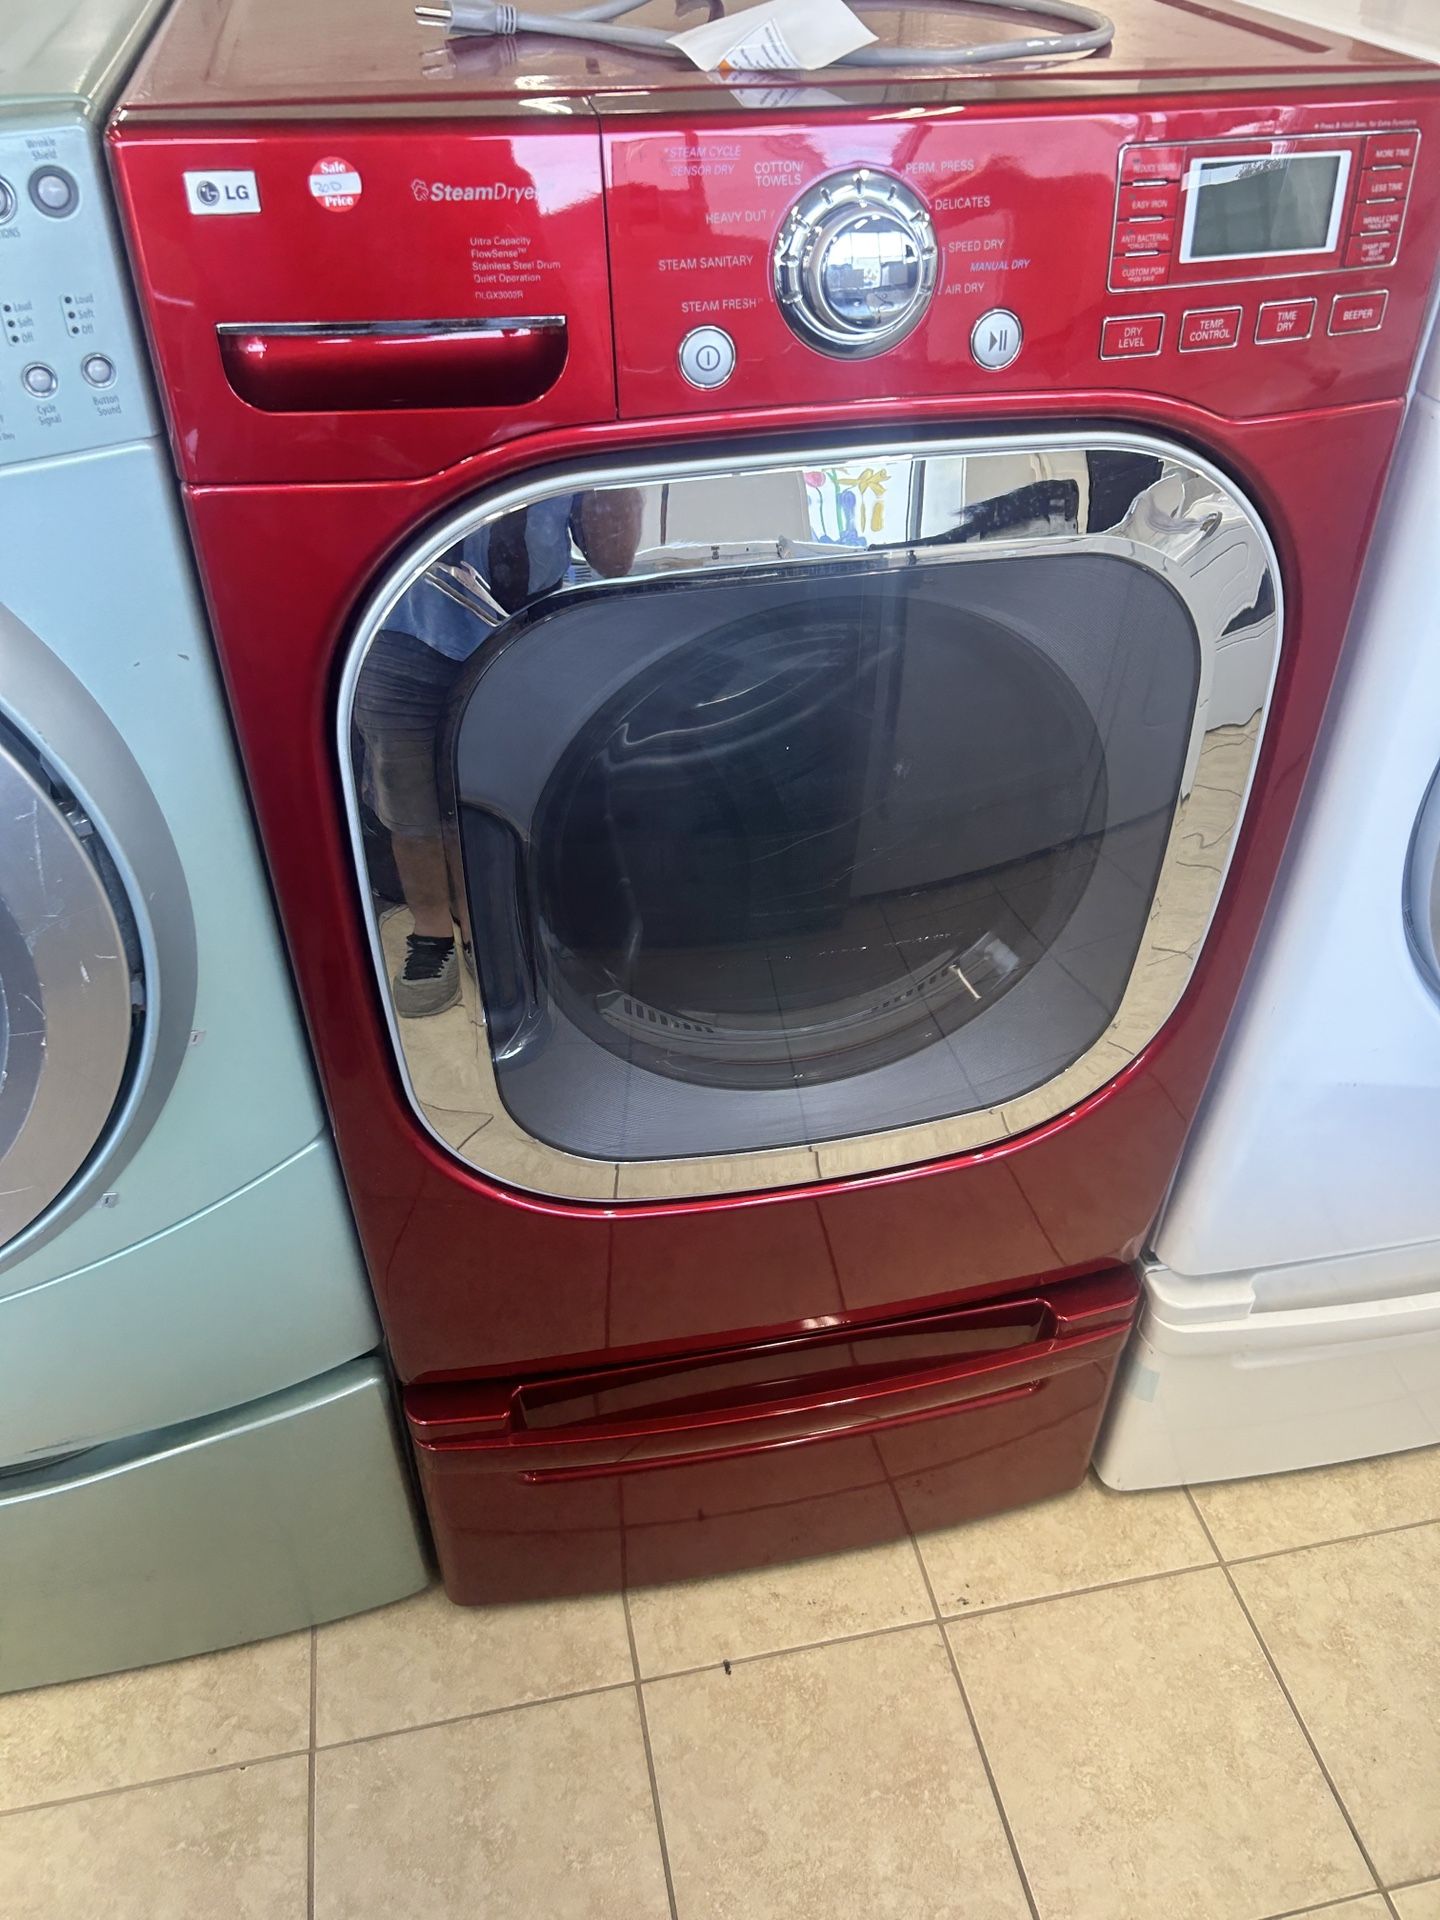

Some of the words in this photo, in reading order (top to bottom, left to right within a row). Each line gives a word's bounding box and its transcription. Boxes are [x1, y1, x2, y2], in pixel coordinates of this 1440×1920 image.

[670, 146, 706, 158] STEAM
[709, 144, 741, 157] CYCLE
[320, 160, 346, 173] Sale
[671, 165, 711, 177] SENSOR
[714, 163, 736, 175] DRY
[941, 159, 974, 172] PRESS
[756, 174, 801, 187] TOWELS
[225, 185, 249, 200] LG
[325, 194, 353, 207] Price
[935, 196, 991, 211] DELICATES
[706, 212, 742, 225] HEAVY
[470, 237, 492, 247] Ultra
[494, 236, 531, 248] Capacity
[1137, 232, 1170, 243] BACTERIAL
[948, 240, 981, 253] SPEED
[984, 238, 1005, 250] DRY
[472, 261, 511, 271] Stainless
[513, 260, 534, 270] Steel
[537, 260, 561, 270] Drum
[658, 258, 697, 271] STEAM
[700, 255, 754, 269] SANITARY
[970, 261, 1009, 272] MANUAL
[1011, 258, 1031, 270] DRY
[473, 274, 497, 283] Quiet
[498, 273, 541, 283] Operation
[1122, 266, 1150, 278] CUSTOM
[946, 284, 962, 295] AIR
[964, 282, 985, 294] DRY
[75, 293, 94, 305] Loud
[14, 302, 32, 313] Loud
[681, 300, 720, 313] STEAM
[78, 309, 95, 320] Soft
[1277, 310, 1297, 322] TIME
[1343, 308, 1373, 321] BEEPER
[18, 317, 34, 327] Soft
[1200, 318, 1224, 329] TEMP.
[1277, 321, 1295, 332] DRY
[82, 324, 94, 335] Off
[1124, 327, 1142, 338] DRY
[1190, 328, 1230, 341] CONTROL
[22, 332, 33, 343] Off
[1118, 337, 1145, 348] LEVEL
[92, 395, 119, 406] Button
[37, 404, 56, 416] Cycle
[97, 405, 122, 417] Sound
[39, 414, 62, 427] Signal
